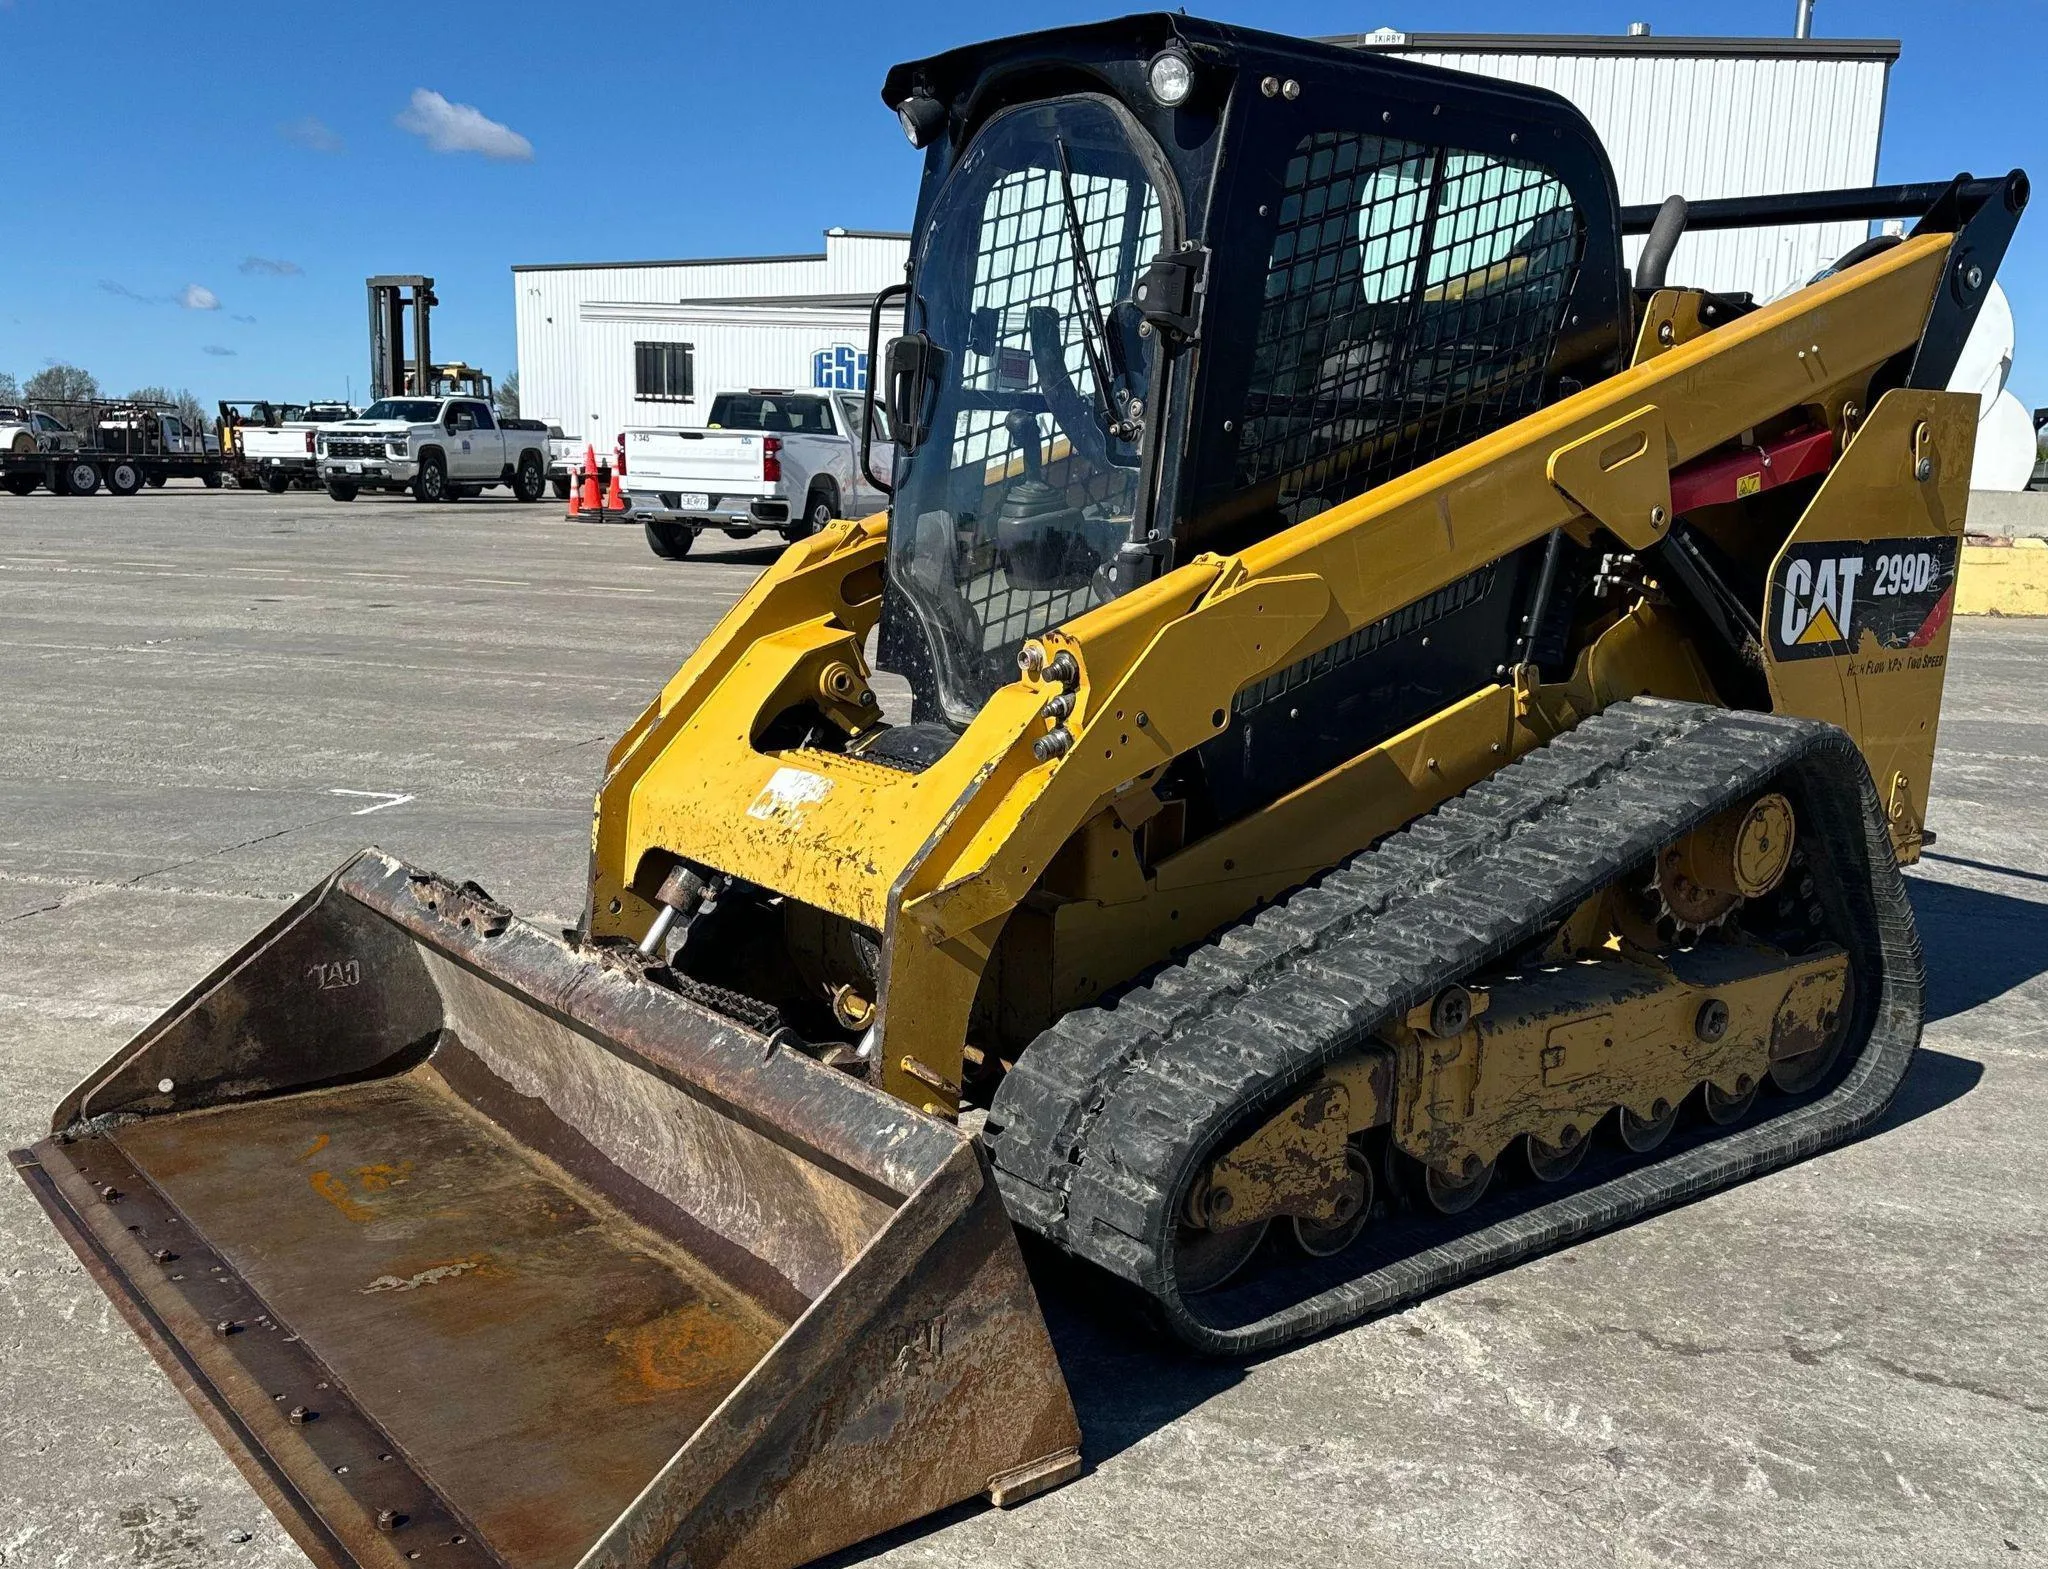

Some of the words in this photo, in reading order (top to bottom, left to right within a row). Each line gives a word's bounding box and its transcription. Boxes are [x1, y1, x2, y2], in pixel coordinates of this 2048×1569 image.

[1378, 34, 1402, 43] KIRBY
[1780, 556, 1864, 647] CAT
[1922, 654, 1944, 669] SPEED
